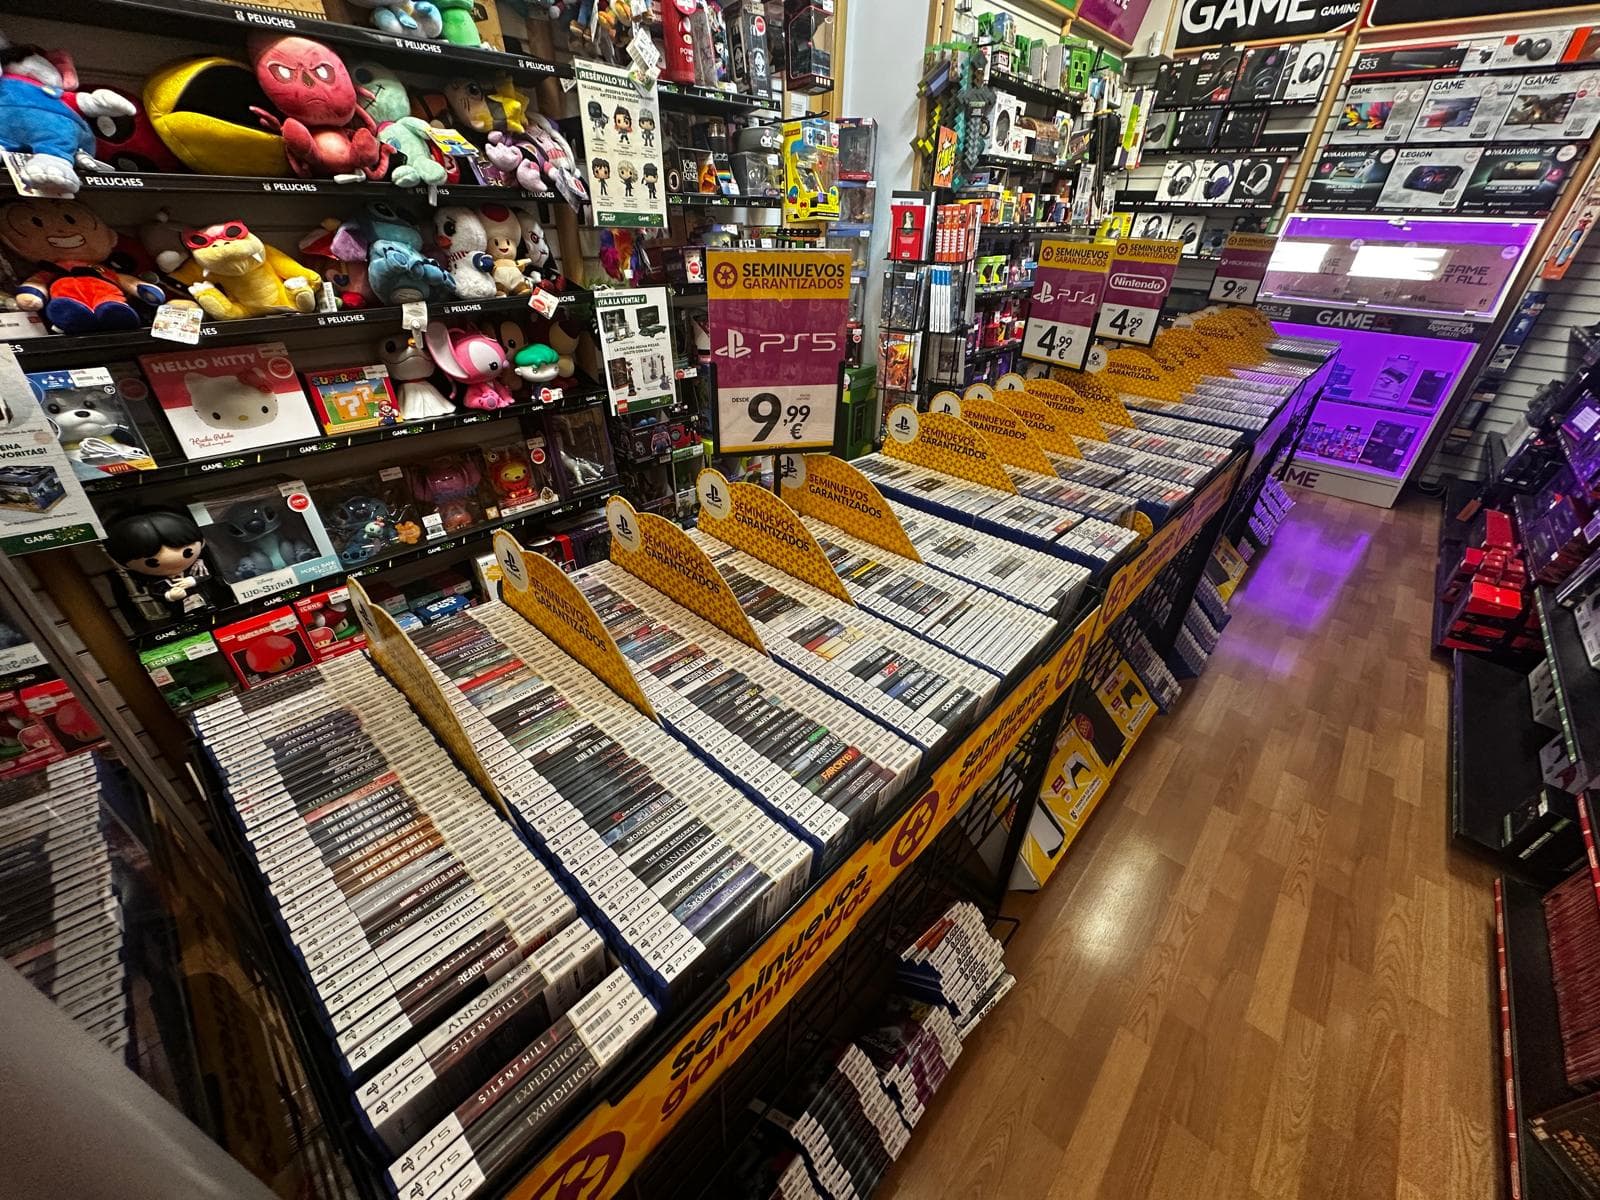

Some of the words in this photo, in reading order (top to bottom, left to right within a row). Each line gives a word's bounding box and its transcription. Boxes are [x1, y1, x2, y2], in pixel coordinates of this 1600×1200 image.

[247, 12, 296, 29] PELUCHES
[1182, 0, 1316, 33] GAME
[404, 39, 442, 54] PELUCHES
[525, 59, 555, 73] PELUCHES
[1351, 86, 1372, 95] GAME
[1433, 79, 1465, 91] GAME
[1525, 74, 1561, 86] GAME
[86, 175, 144, 188] PELUCHES
[274, 183, 317, 192] PELUCHES
[528, 190, 555, 199] PELUCHES
[1056, 247, 1109, 260] SEMINUEVOS
[1128, 250, 1177, 261] GARANTIZADOS
[1130, 243, 1179, 255] SEMINUEVOS
[742, 262, 845, 279] SEMINUEVOS
[1054, 256, 1107, 268] GARANTIZADOS
[742, 277, 844, 290] GARANTIZADOS
[1112, 276, 1163, 291] Nintendo
[451, 303, 482, 313] PELUCHES
[1056, 288, 1096, 305] PS4
[327, 313, 365, 323] PELUCHES
[1109, 309, 1143, 335] 4,99
[1316, 310, 1375, 329] GAME
[759, 333, 838, 353] PS5
[1037, 326, 1073, 357] 4,99
[1128, 327, 1136, 338] €
[150, 357, 208, 374] HELLO
[212, 353, 256, 368] KITTY
[1058, 349, 1067, 359] €
[748, 392, 811, 442] 9,99
[963, 410, 1016, 428] SEMINUEVOS
[790, 423, 802, 440] €
[921, 425, 976, 447] SEMINUEVOS
[920, 436, 988, 460] GARANTIZADOS
[809, 473, 869, 503] SEMINUEVOS
[809, 485, 882, 519] GARANTIZADOS
[735, 500, 794, 534] SEMINUEVOS
[24, 533, 56, 544] GAME
[735, 512, 810, 552] GARANTIZADOS
[643, 532, 704, 574] SEMINUEVOS
[645, 545, 720, 594] GARANTIZADOS
[531, 576, 590, 627] SEMINUEVOS
[534, 591, 607, 652] GARANTIZADOS
[155, 630, 177, 640] GAME
[275, 724, 305, 742] ASTRO
[307, 717, 326, 731] BOT
[284, 730, 315, 747] ASTRO
[315, 722, 335, 733] BOT
[285, 739, 316, 757] ASTRO
[317, 731, 337, 742] BOT
[626, 821, 656, 845] MONSTER
[423, 902, 452, 926] SILENT
[453, 891, 471, 907] HILL
[432, 914, 461, 938] SILENT
[462, 905, 480, 920] HILL
[650, 922, 672, 942] PS5
[661, 933, 685, 955] PS5
[674, 944, 698, 969] PS5
[458, 961, 486, 985] READY
[670, 864, 869, 1081] seminuevos
[660, 880, 872, 1121] garantizados
[447, 999, 489, 1034] ANNO
[452, 1017, 492, 1053] SILENT
[494, 996, 519, 1018] HILL
[381, 1055, 414, 1085] PS5
[478, 1065, 521, 1104] SILENT
[521, 1040, 548, 1065] HILL
[514, 1037, 584, 1104] EXPEDITION
[390, 1072, 424, 1104] PS5
[525, 1057, 597, 1127] EXPEDITION
[416, 1126, 451, 1161] PS5
[425, 1150, 461, 1186] PS5
